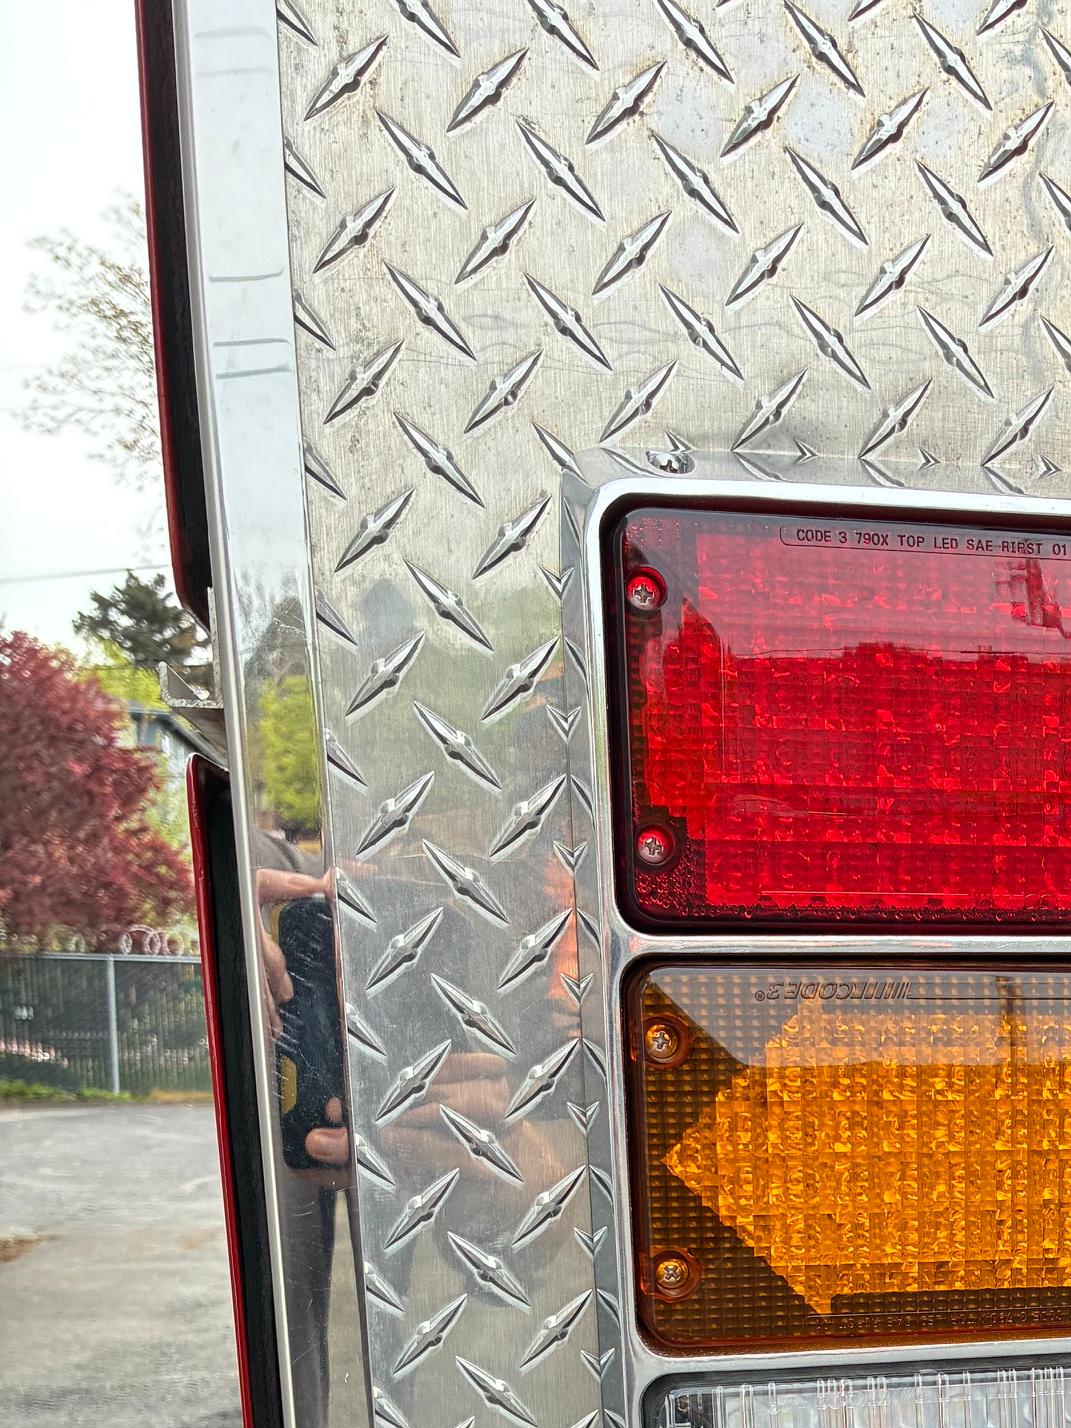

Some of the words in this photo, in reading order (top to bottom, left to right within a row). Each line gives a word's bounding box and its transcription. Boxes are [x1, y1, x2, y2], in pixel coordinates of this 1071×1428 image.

[797, 529, 831, 542] CODE
[838, 531, 848, 543] 3
[855, 532, 889, 546] 790X
[898, 534, 925, 548] TOP
[934, 536, 958, 549] LED
[966, 538, 992, 552] SAE
[1052, 543, 1067, 556] 01
